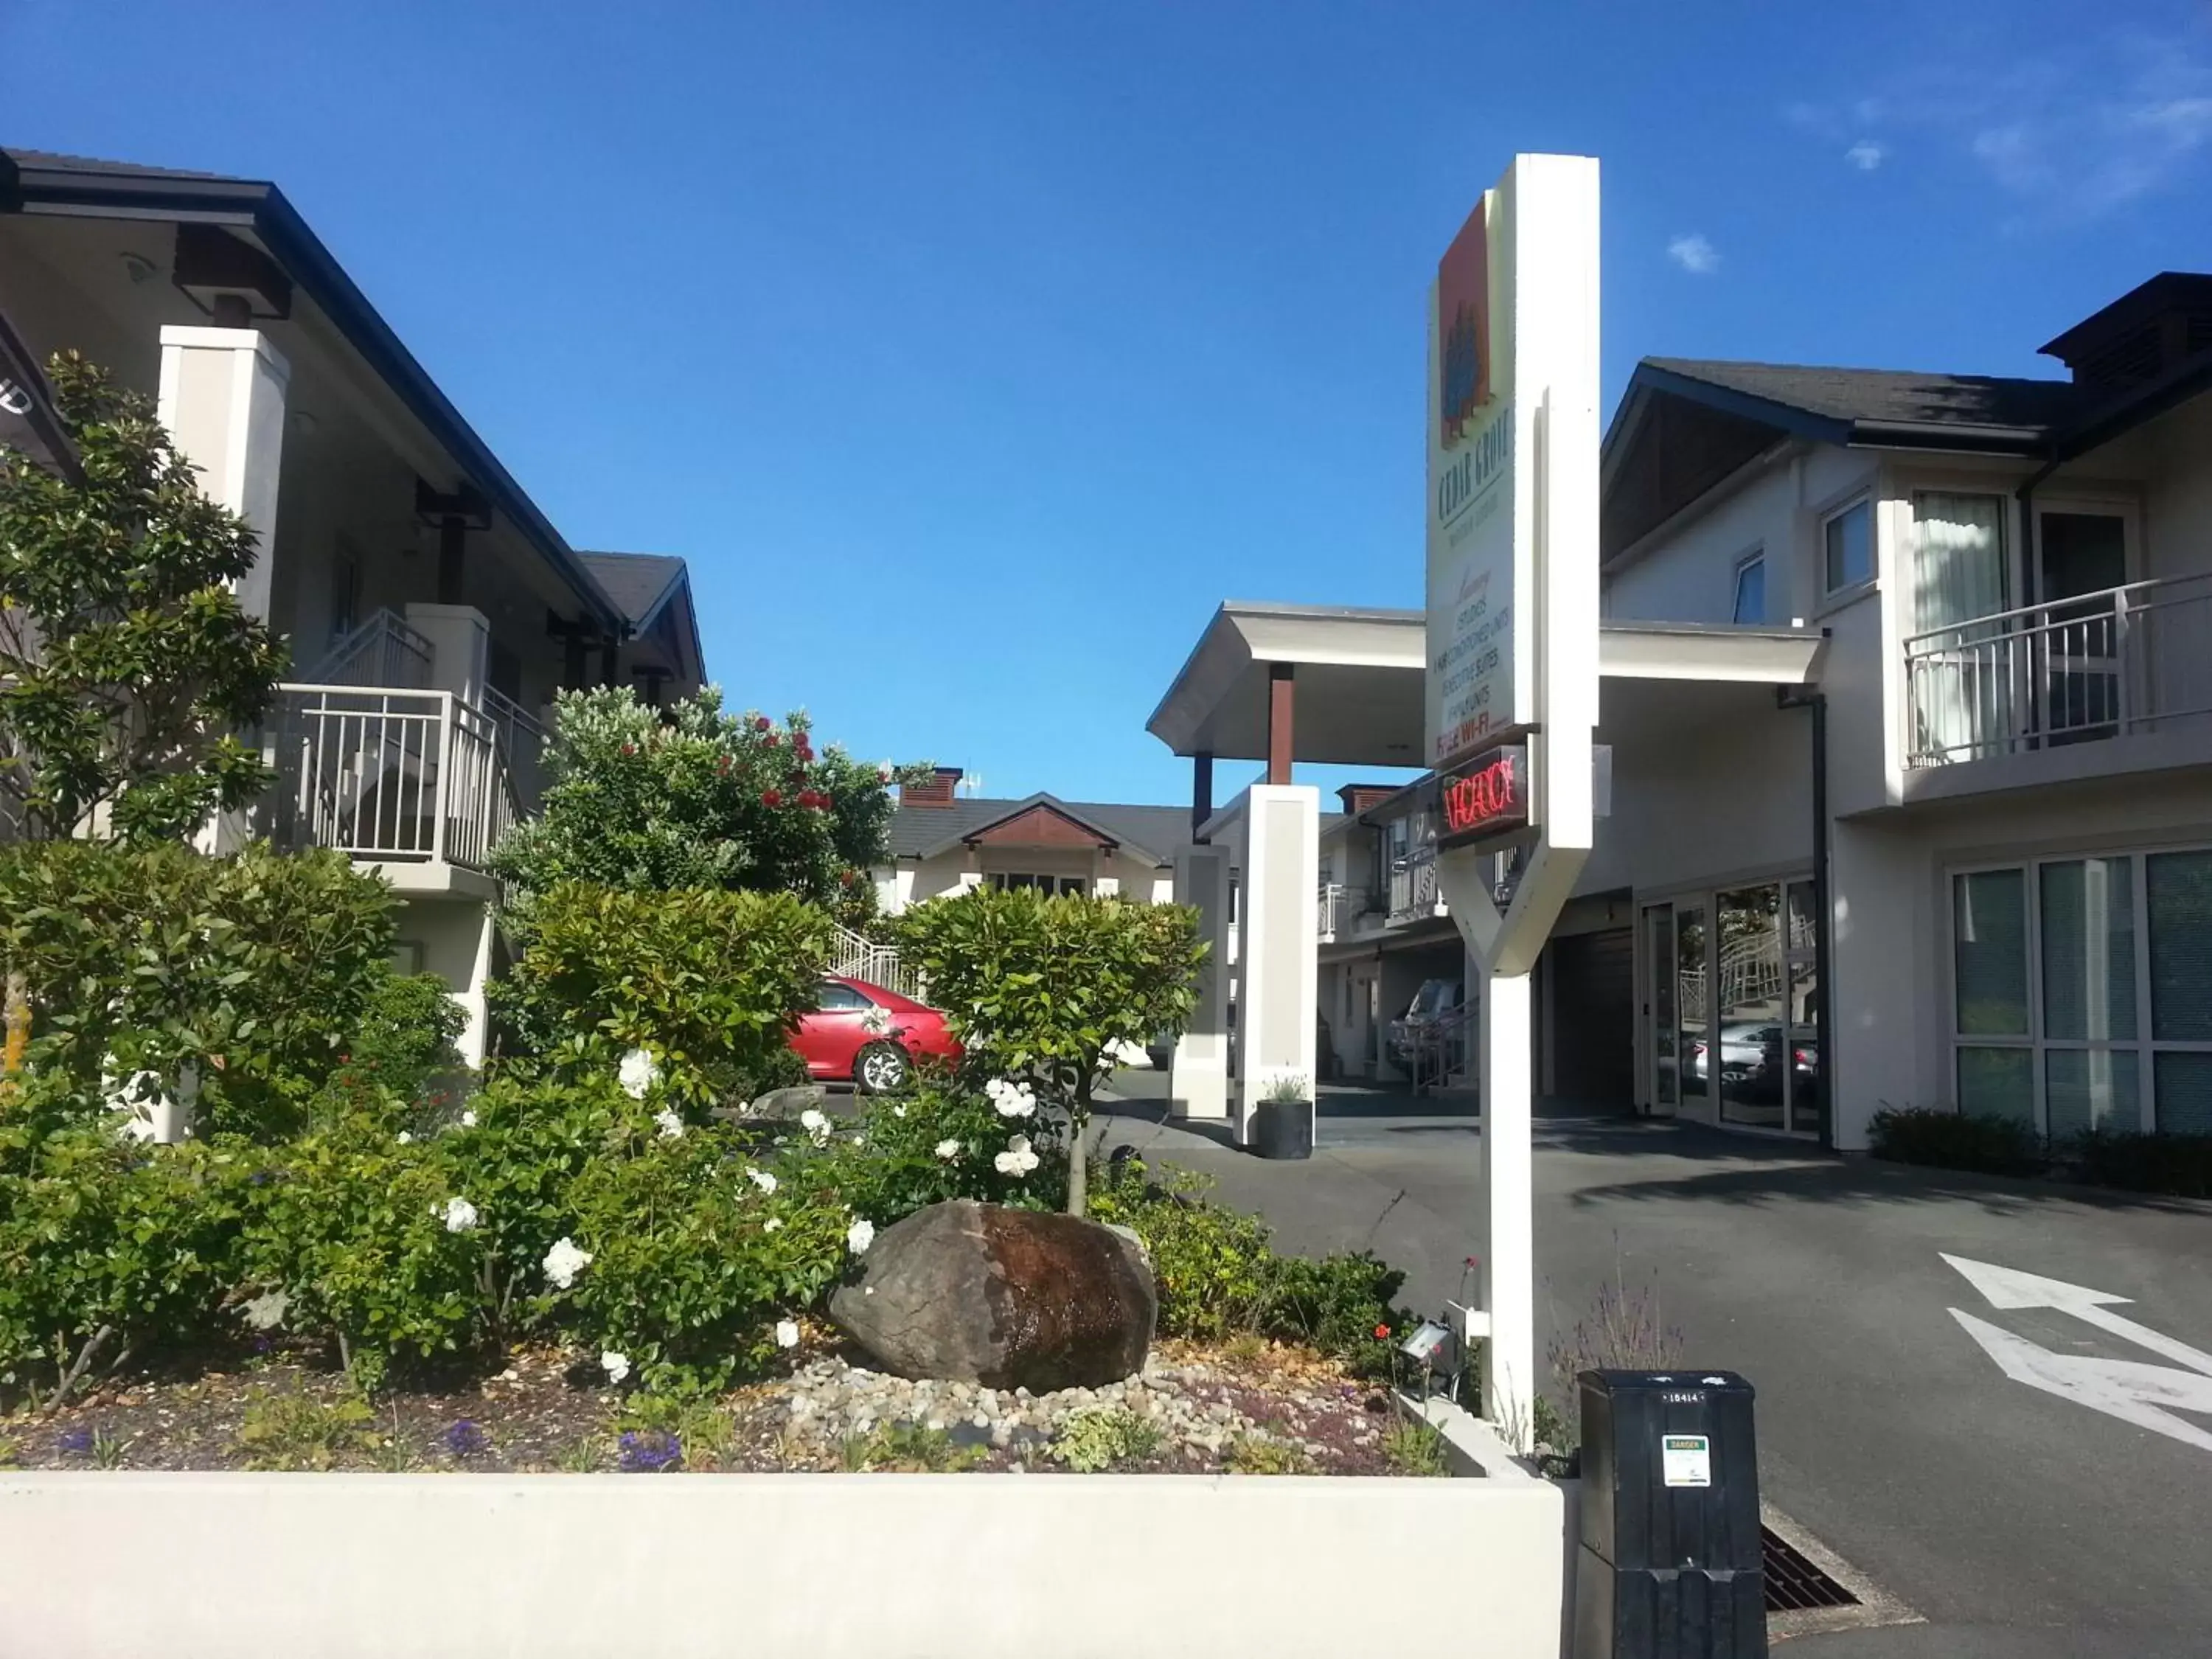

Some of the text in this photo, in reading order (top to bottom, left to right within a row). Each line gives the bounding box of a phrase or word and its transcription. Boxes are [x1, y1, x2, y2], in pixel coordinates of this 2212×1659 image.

[1439, 408, 1509, 521] CEDAR GROVE
[1437, 728, 1458, 757] FREE
[1444, 755, 1516, 830] VACANCY
